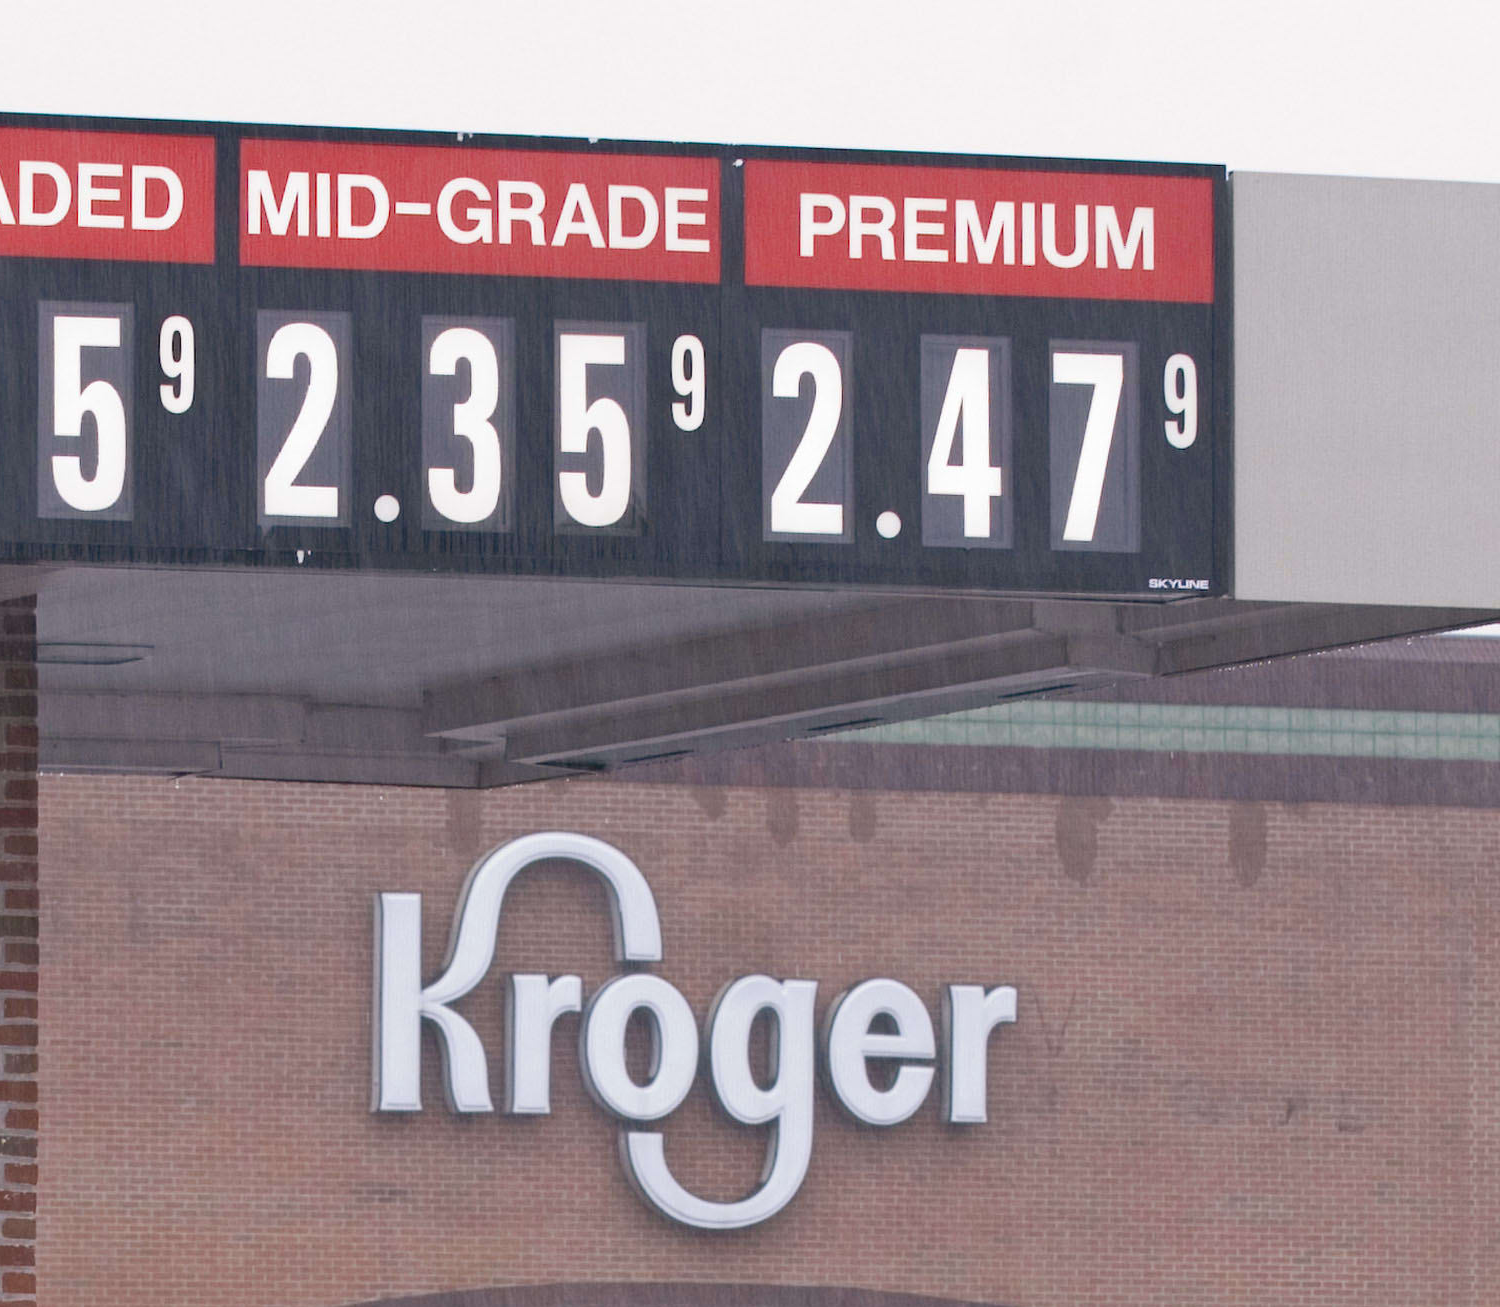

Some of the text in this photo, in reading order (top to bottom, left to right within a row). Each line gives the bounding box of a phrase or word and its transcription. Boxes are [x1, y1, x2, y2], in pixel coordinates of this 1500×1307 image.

[246, 169, 711, 254] MID-GRADE
[799, 192, 1156, 272] PREMIUM
[1148, 578, 1210, 590] SKYLINE
[373, 831, 1018, 1230] Kroger
